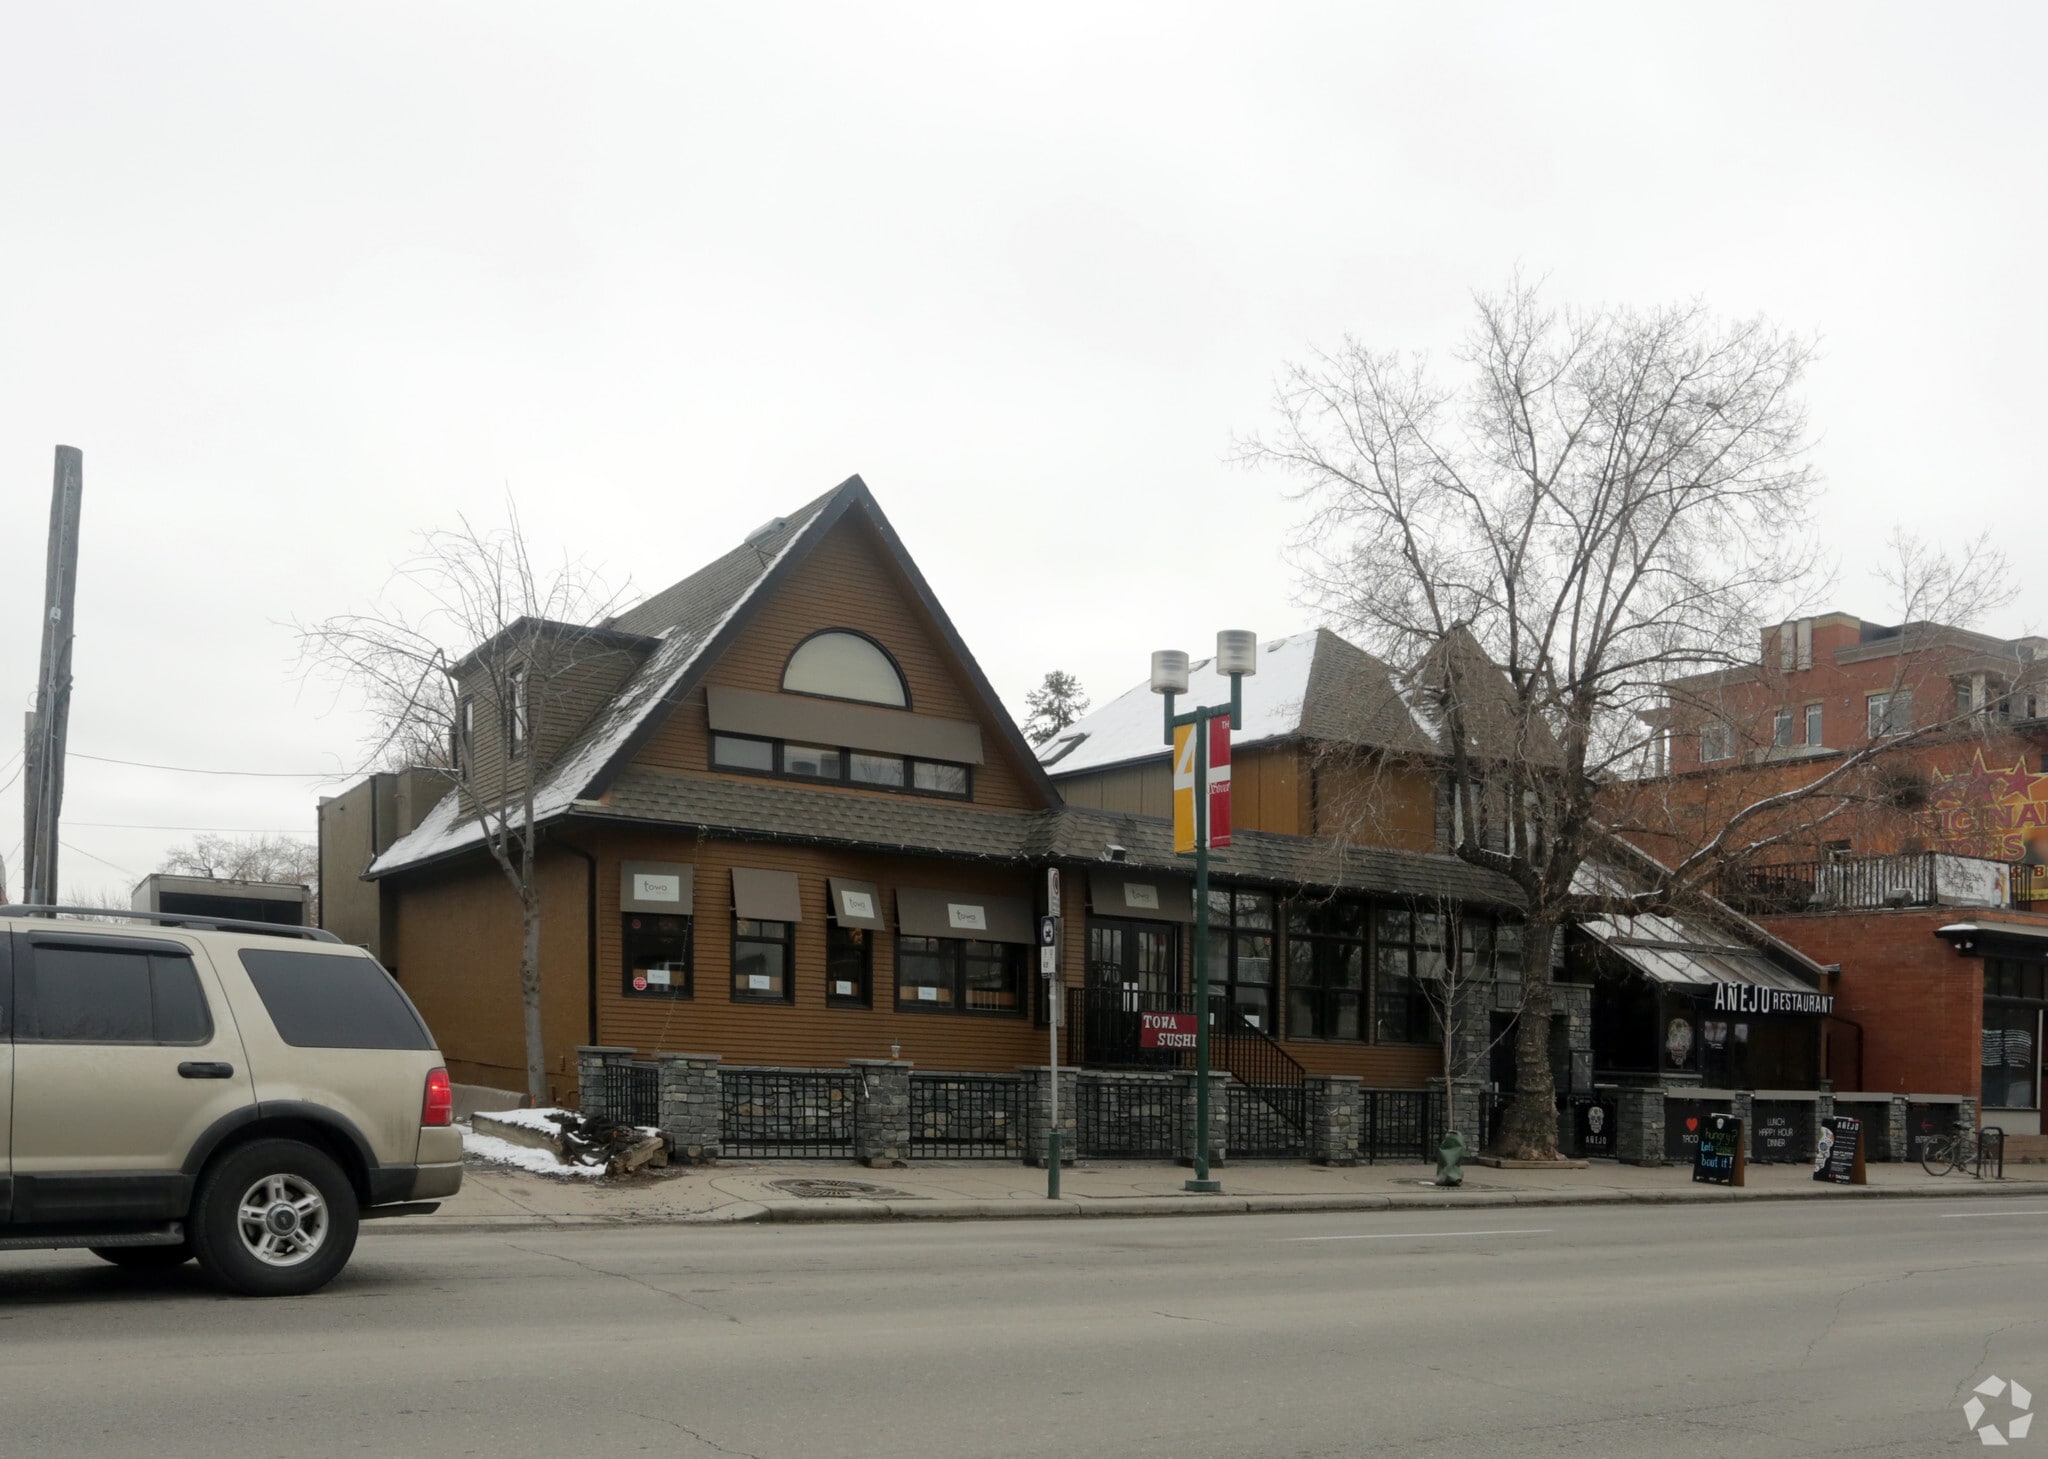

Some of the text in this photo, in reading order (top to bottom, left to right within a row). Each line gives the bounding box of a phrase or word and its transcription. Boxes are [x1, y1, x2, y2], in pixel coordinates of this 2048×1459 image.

[1221, 720, 1230, 730] TH
[1890, 803, 2048, 838] ORIGINA
[1714, 981, 1834, 1014] AÑEJO RESTAURANT
[1143, 1015, 1177, 1030] TOWA
[1157, 1033, 1197, 1048] SUSHI
[1767, 1117, 1786, 1127] LUNCH
[1758, 1127, 1793, 1137] HAPPY HOUR
[1767, 1138, 1786, 1148] DINNER
